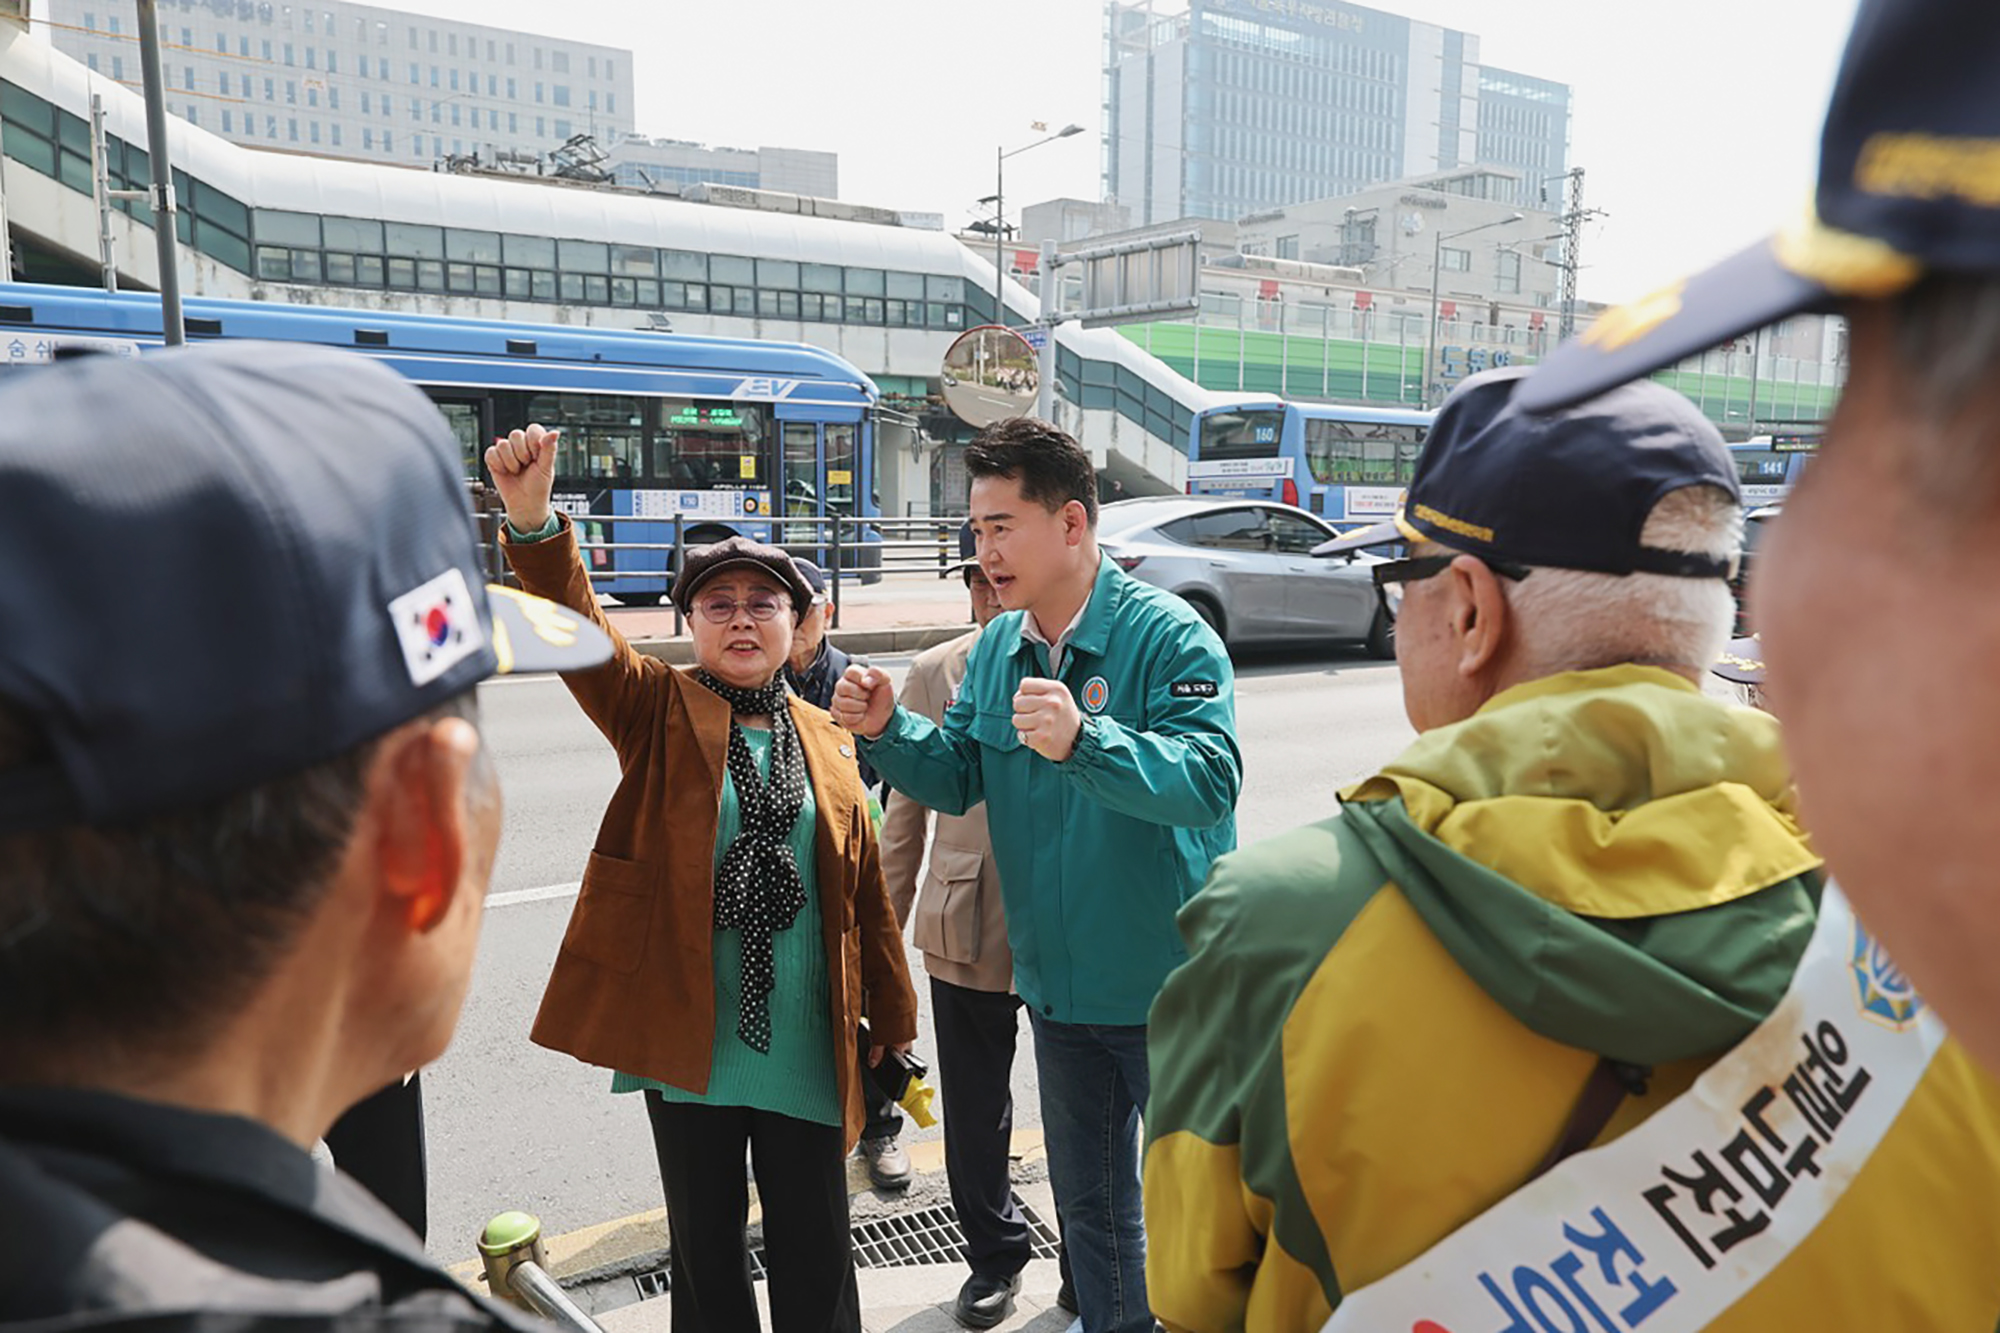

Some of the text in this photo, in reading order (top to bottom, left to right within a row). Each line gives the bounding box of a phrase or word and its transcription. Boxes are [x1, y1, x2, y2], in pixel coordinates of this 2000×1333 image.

[8, 339, 27, 358] 숨
[743, 378, 791, 397] EV
[1255, 427, 1274, 442] 160
[1763, 461, 1783, 475] 141
[1641, 1020, 1872, 1270] 월남전
